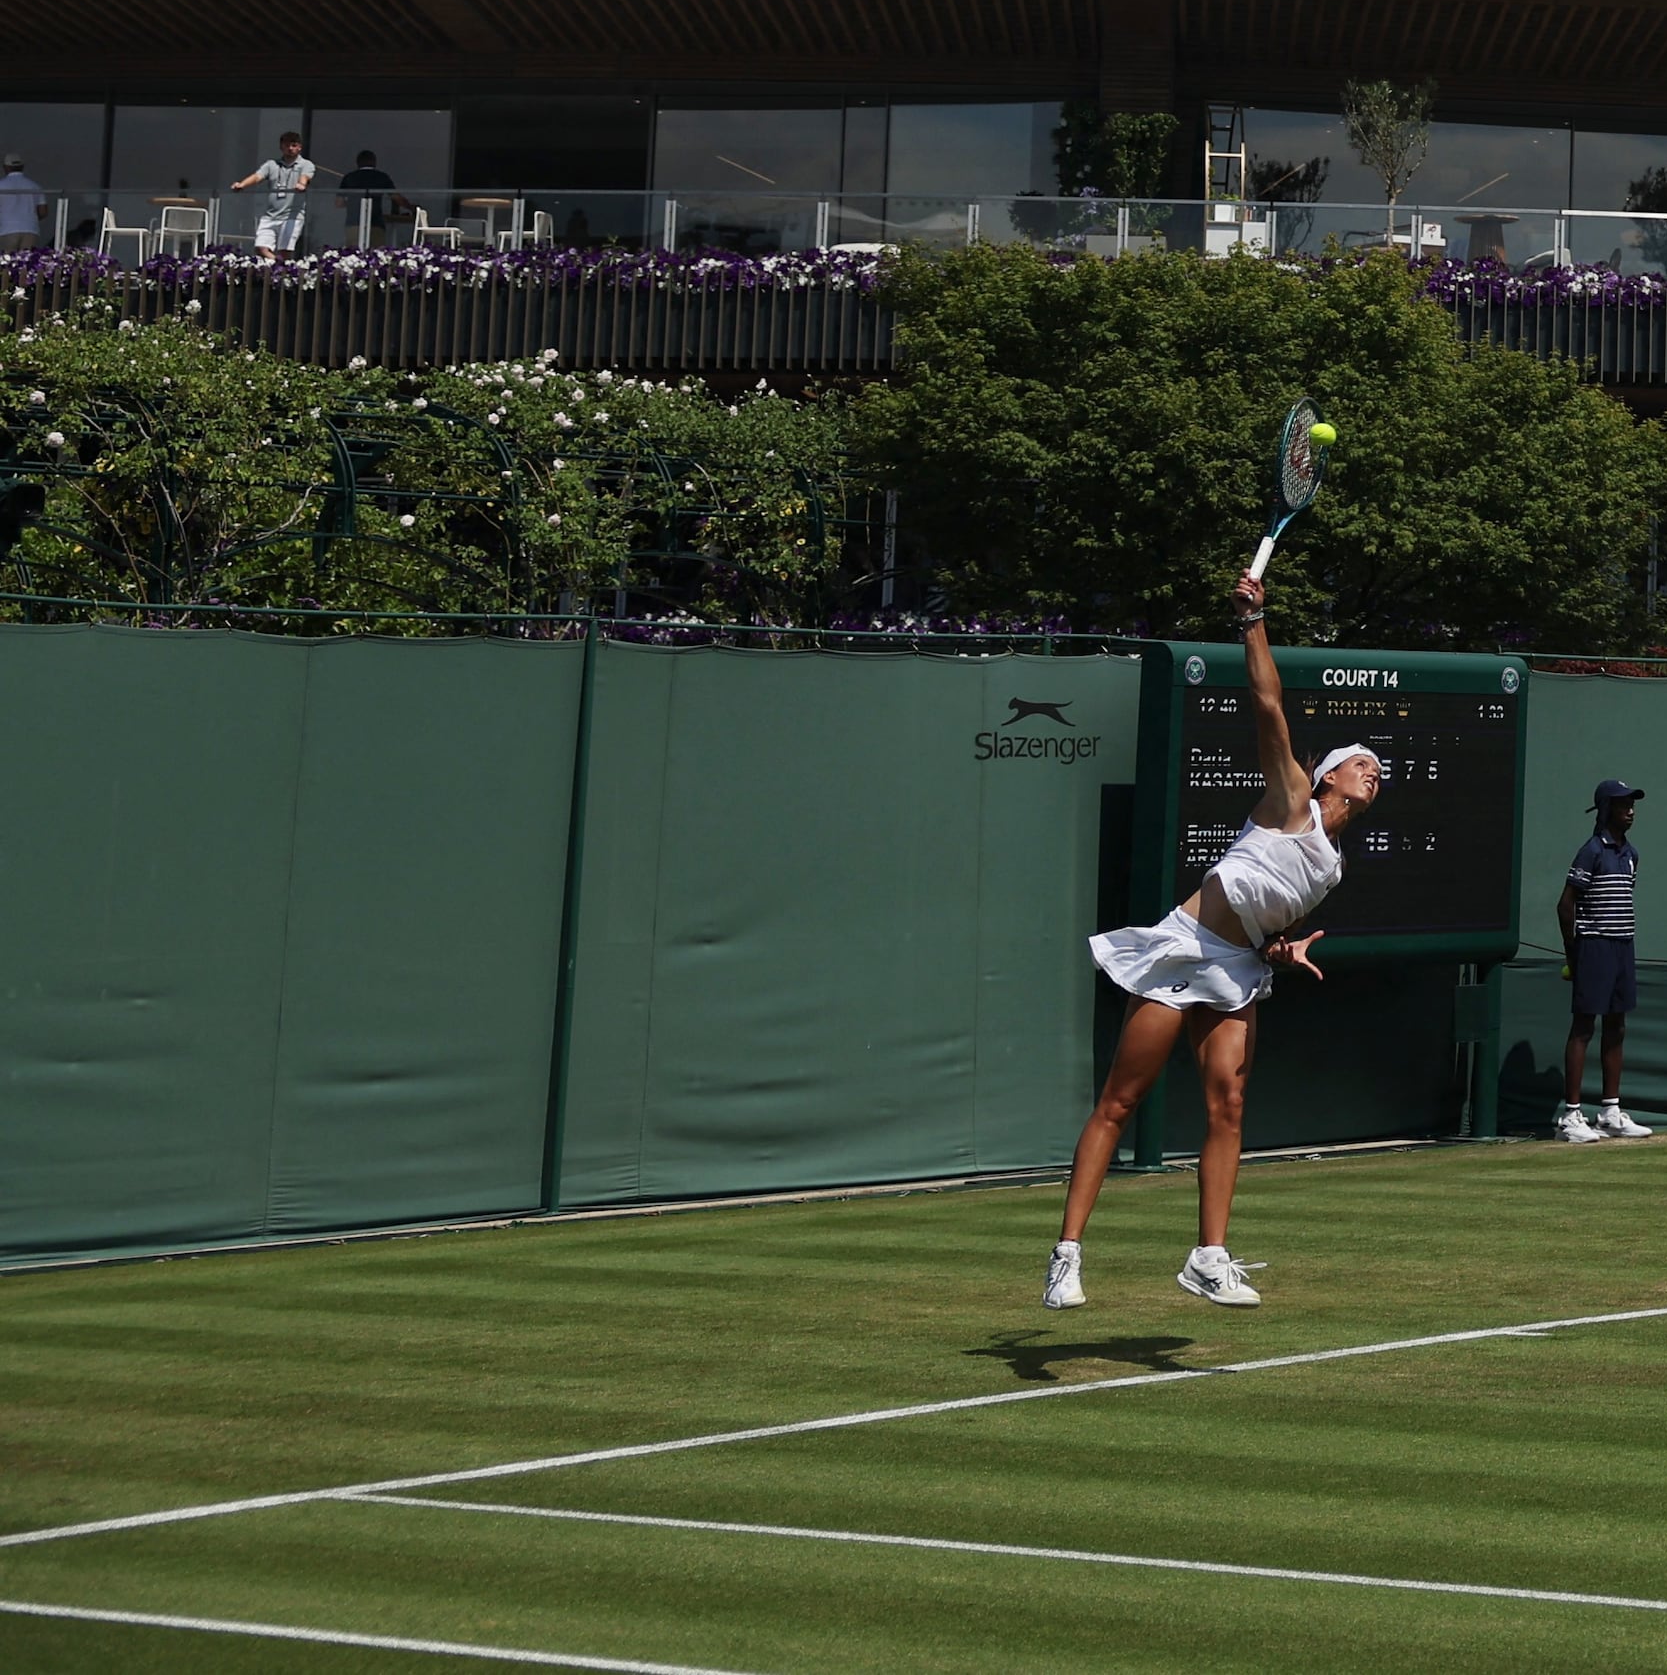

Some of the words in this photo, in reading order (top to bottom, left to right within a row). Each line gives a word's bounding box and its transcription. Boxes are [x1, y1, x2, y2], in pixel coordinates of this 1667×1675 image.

[1322, 668, 1378, 687] COURT
[1382, 670, 1399, 688] 14
[1327, 700, 1388, 716] ROLEX
[974, 731, 1102, 765] Slazenger
